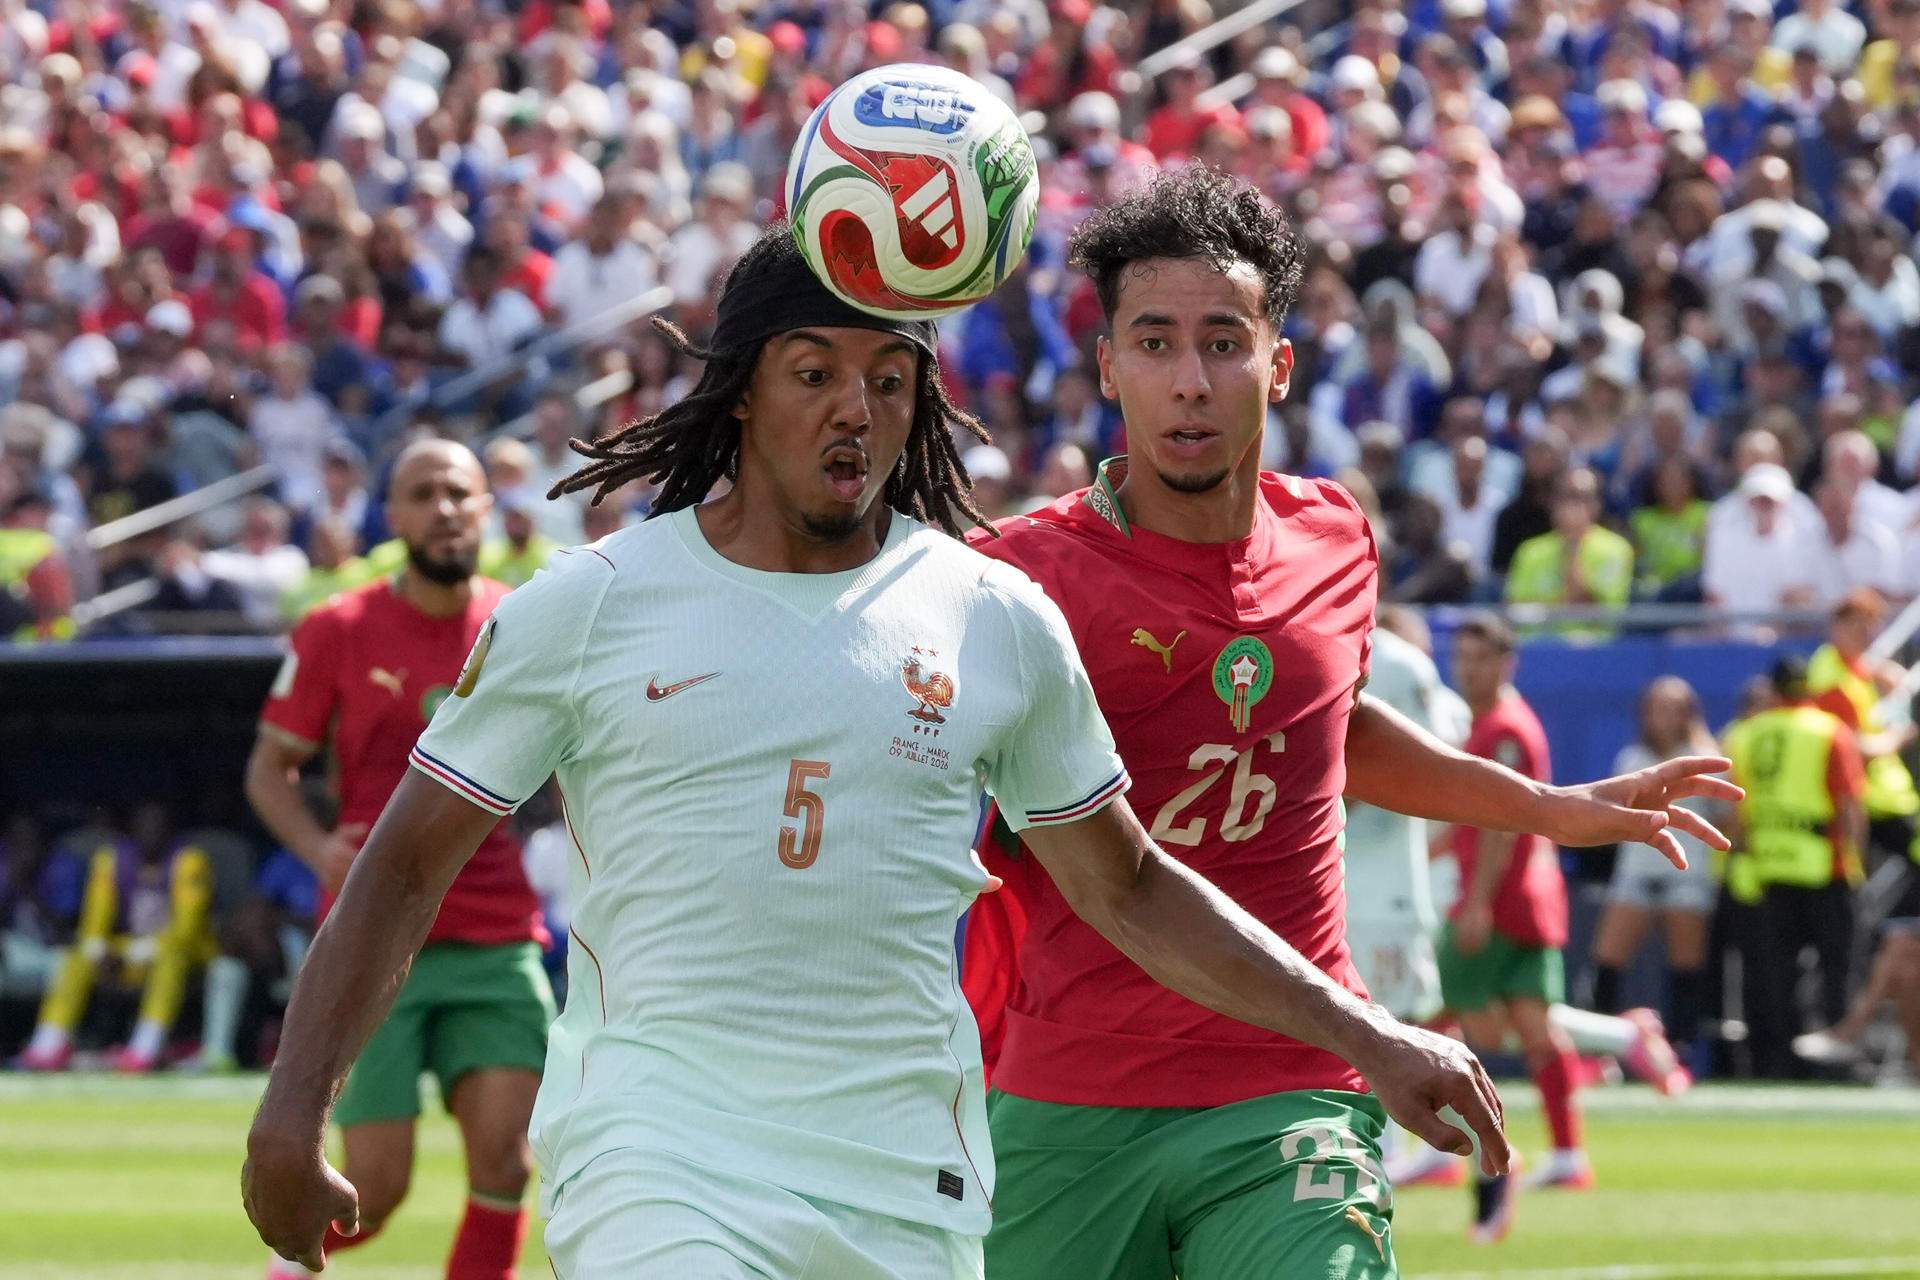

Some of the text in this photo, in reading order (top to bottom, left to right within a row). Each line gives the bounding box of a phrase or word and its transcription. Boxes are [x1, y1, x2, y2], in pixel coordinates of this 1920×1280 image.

[914, 725, 939, 737] FFF
[889, 747, 949, 770] 09 JUILLET 2026
[892, 736, 919, 751] FRANCE
[927, 746, 950, 760] MAROC
[1149, 730, 1286, 846] 26
[778, 758, 832, 870] 5
